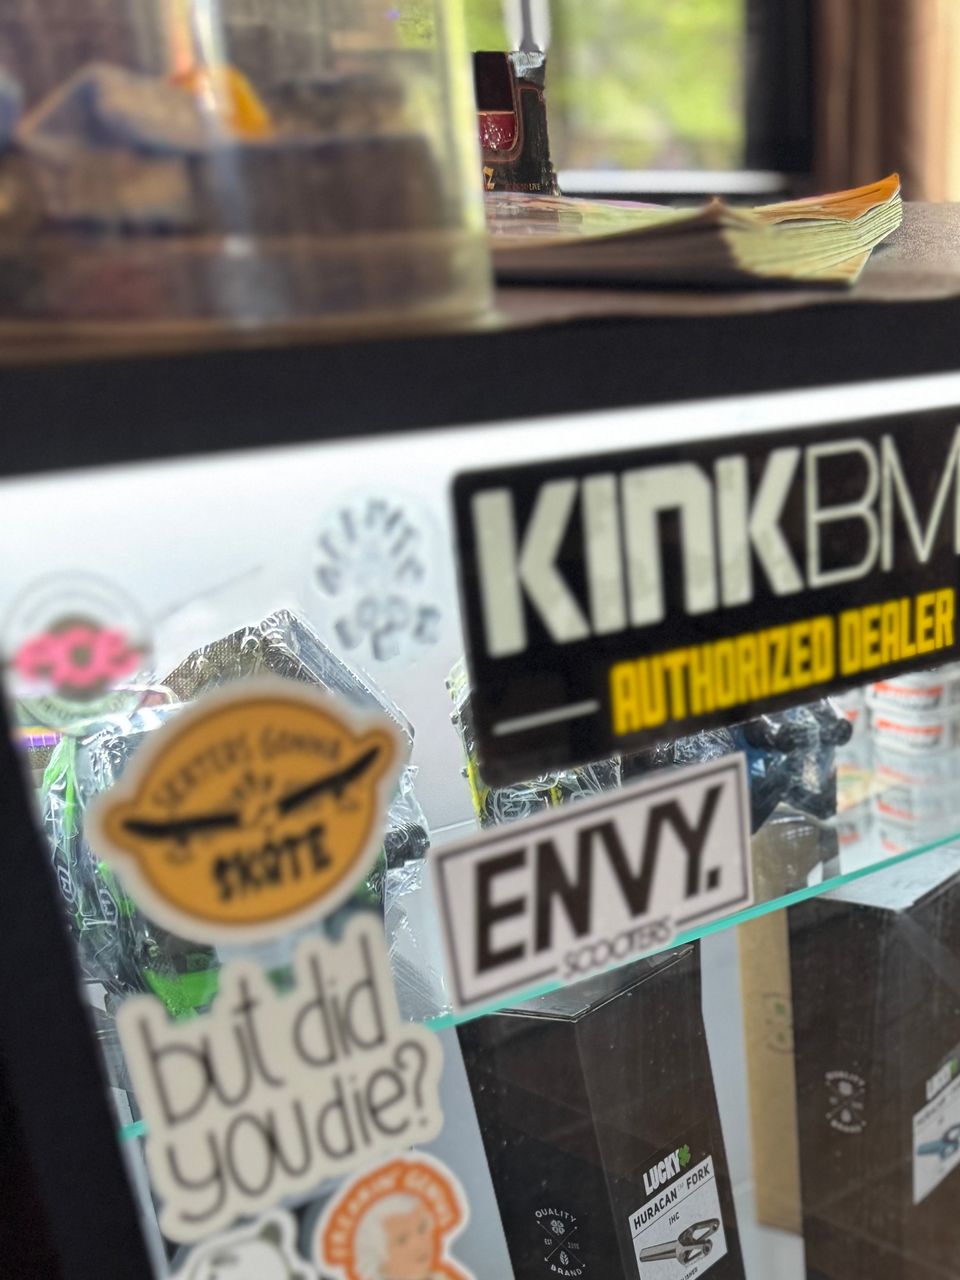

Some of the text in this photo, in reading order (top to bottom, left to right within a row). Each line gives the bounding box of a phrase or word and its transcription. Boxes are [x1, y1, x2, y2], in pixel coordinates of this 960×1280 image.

[610, 588, 955, 735] AUTHORIZED DEALER
[559, 919, 673, 978] SCOOTERS
[139, 933, 386, 1127] but did
[643, 1148, 681, 1196] LUCKY
[686, 1163, 711, 1190] FORK
[535, 1208, 577, 1223] QUALITY
[551, 1264, 583, 1277] BRAND
